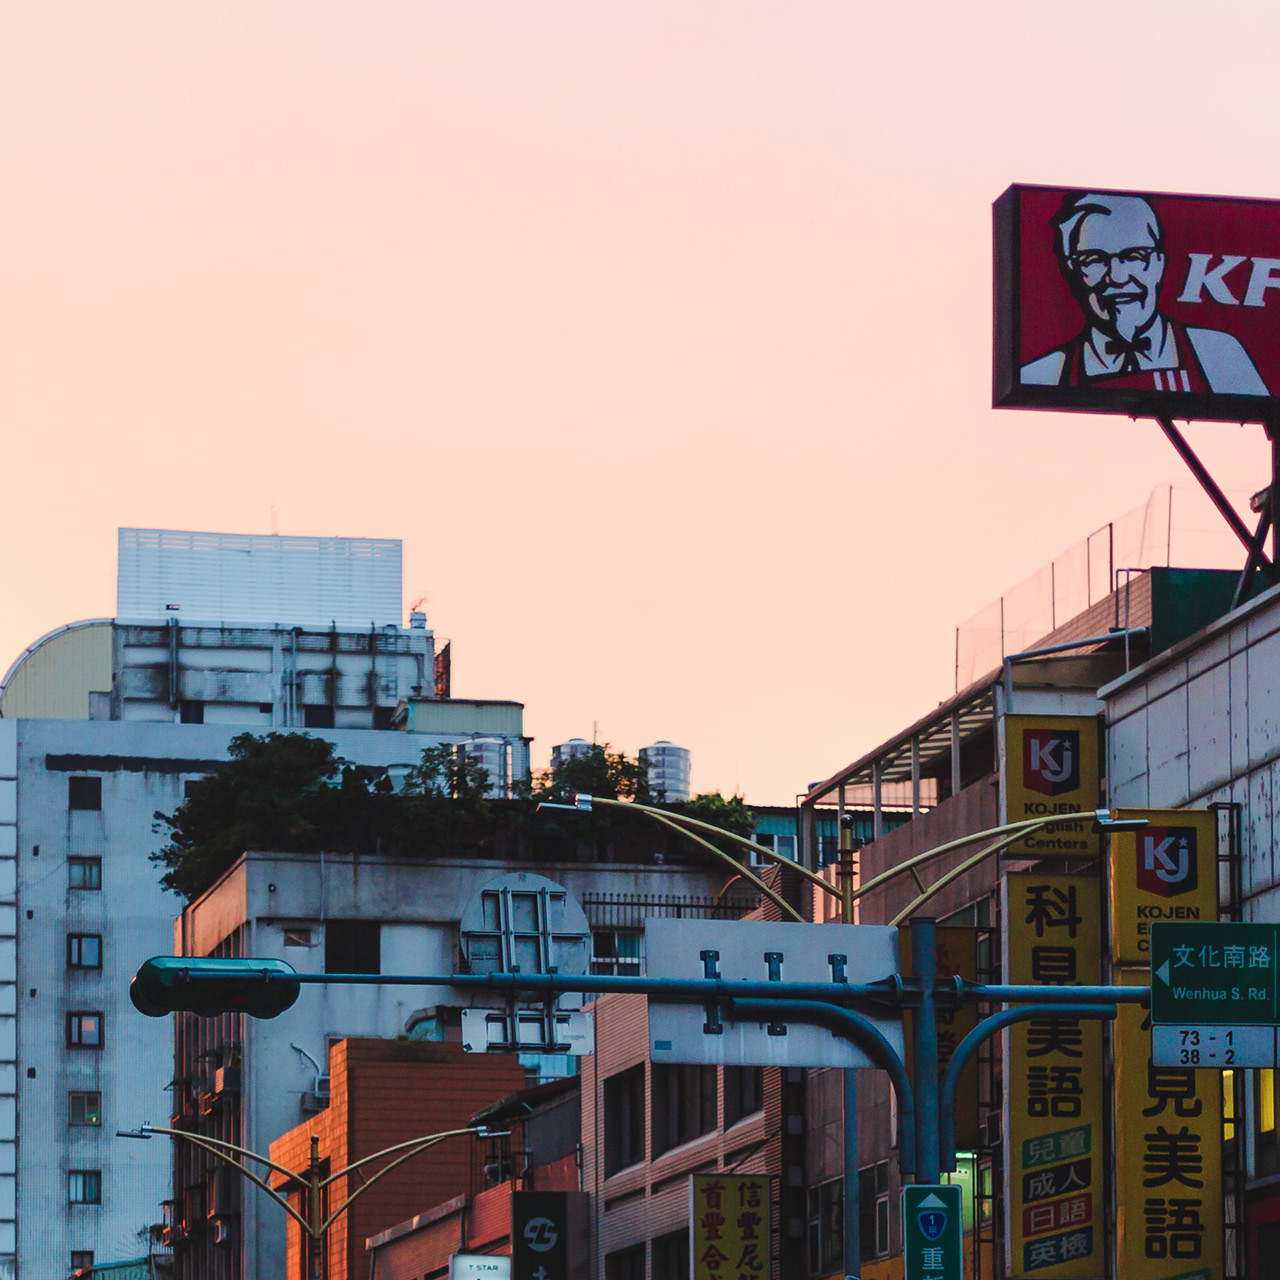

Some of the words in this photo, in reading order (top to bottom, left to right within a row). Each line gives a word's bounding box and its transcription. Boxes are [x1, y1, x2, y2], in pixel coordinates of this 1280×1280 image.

[1024, 802, 1081, 815] KOJEN
[1024, 837, 1088, 850] Centers
[1137, 905, 1200, 919] KOJEN
[1172, 944, 1271, 969] 文化南路
[1025, 885, 1083, 1118] 科見美語
[1173, 987, 1227, 1000] Wenhua
[1231, 987, 1244, 1000] S.
[1248, 987, 1270, 1000] Rd.
[1180, 1030, 1200, 1046] 73
[1180, 1049, 1200, 1065] 38
[1029, 1130, 1087, 1165] 兒童
[1142, 1020, 1205, 1259] 見美語
[1029, 1165, 1087, 1200] 成人
[1030, 1200, 1087, 1232] 日語
[1030, 1235, 1088, 1268] 英檢
[476, 1264, 499, 1272] STAR
